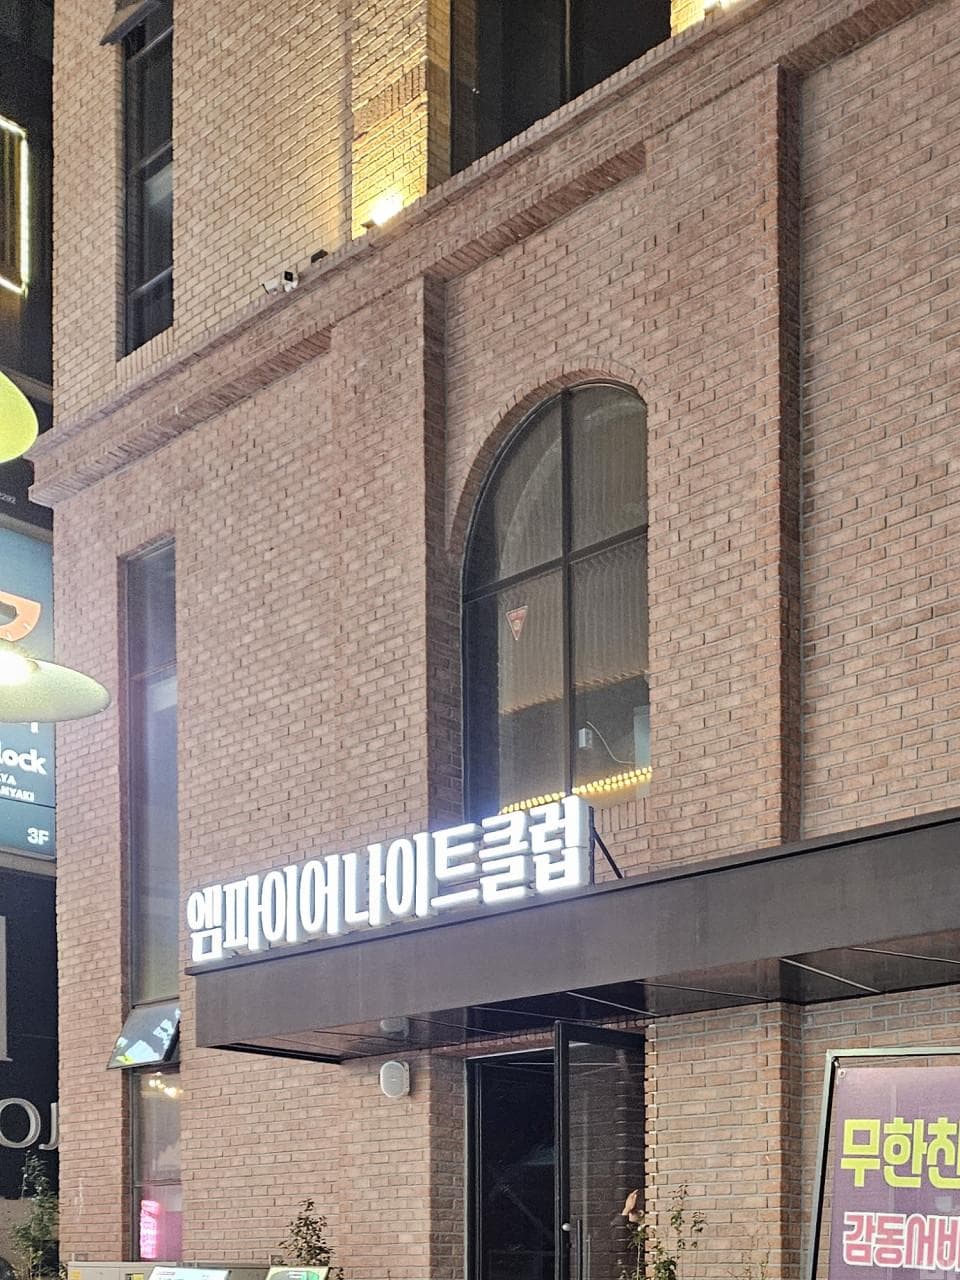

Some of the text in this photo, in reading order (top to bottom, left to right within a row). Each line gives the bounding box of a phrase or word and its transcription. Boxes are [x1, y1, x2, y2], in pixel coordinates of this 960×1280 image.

[0, 742, 47, 775] ock
[27, 827, 49, 845] 3F
[186, 794, 591, 963] 엠파이어나이트클럽
